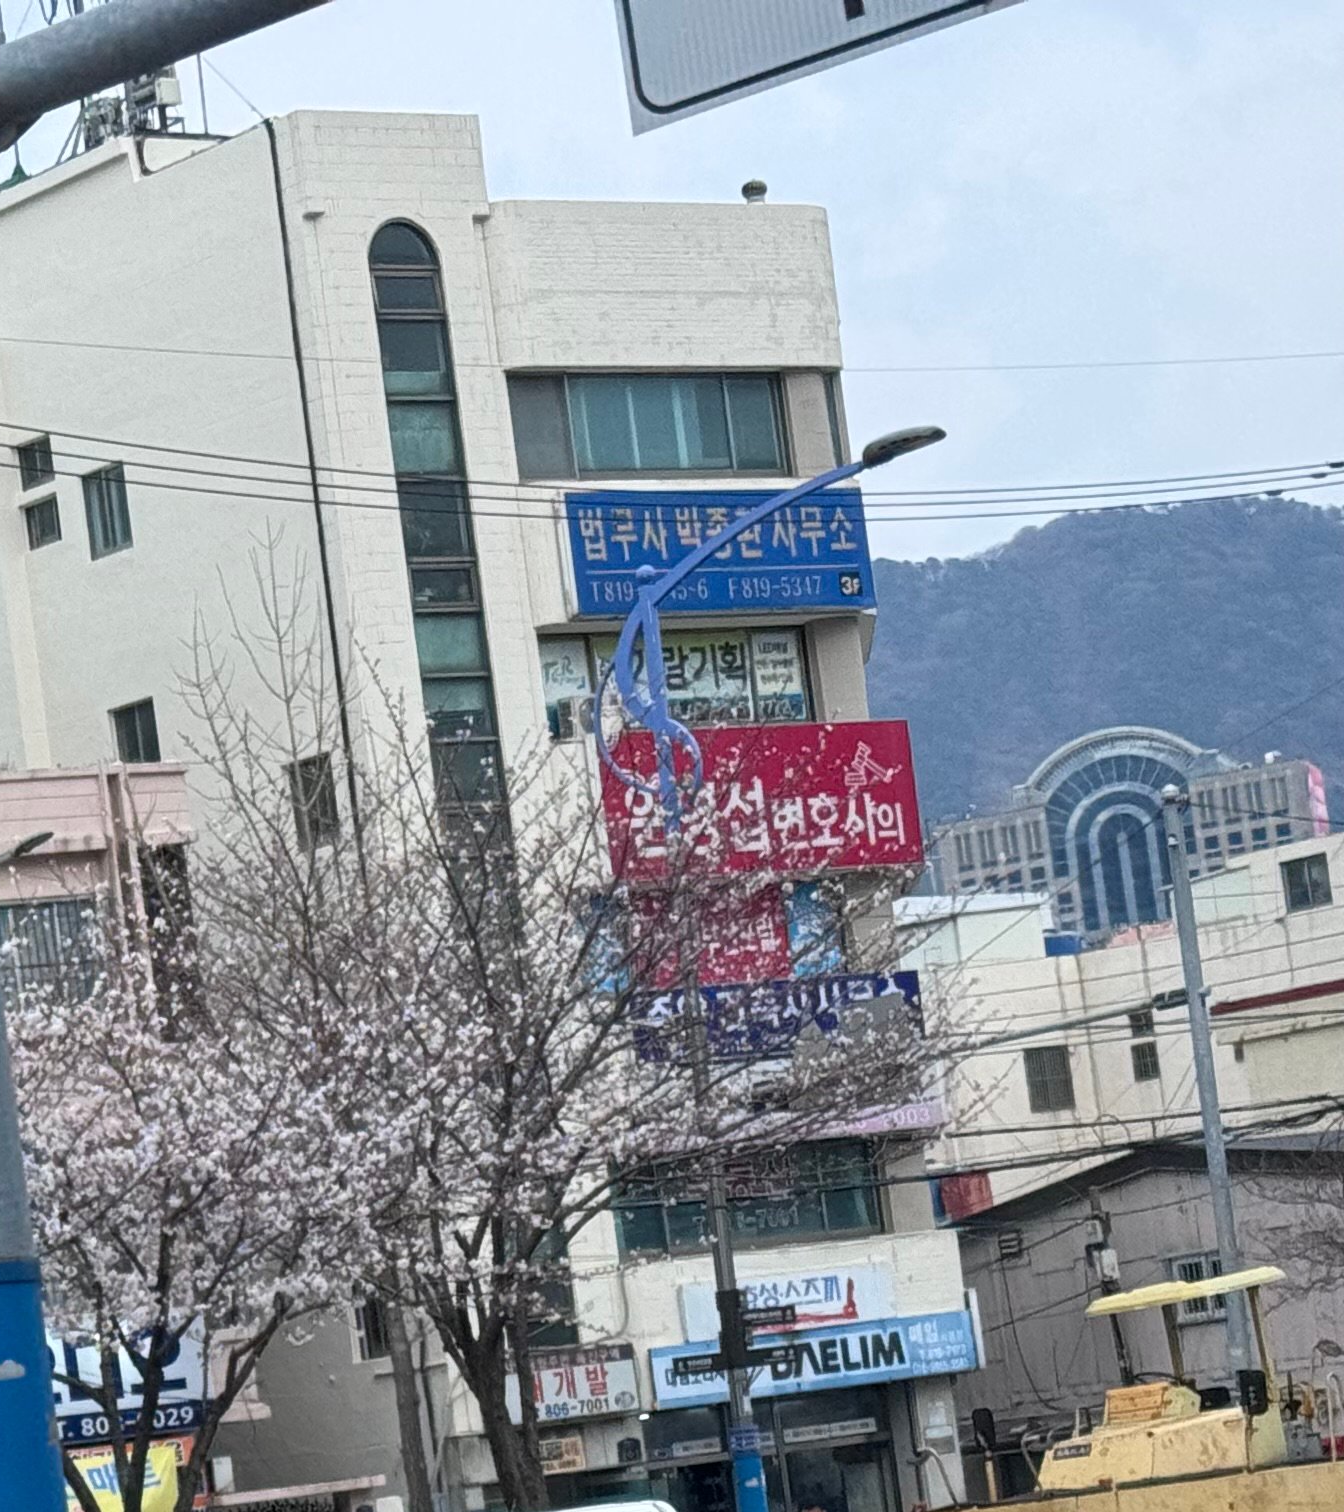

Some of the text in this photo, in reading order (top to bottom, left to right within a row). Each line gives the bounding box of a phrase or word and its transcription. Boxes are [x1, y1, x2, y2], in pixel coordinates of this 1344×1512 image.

[579, 506, 668, 561] 법무사
[772, 505, 858, 558] 사무소
[80, 1405, 195, 1437] 80-029
